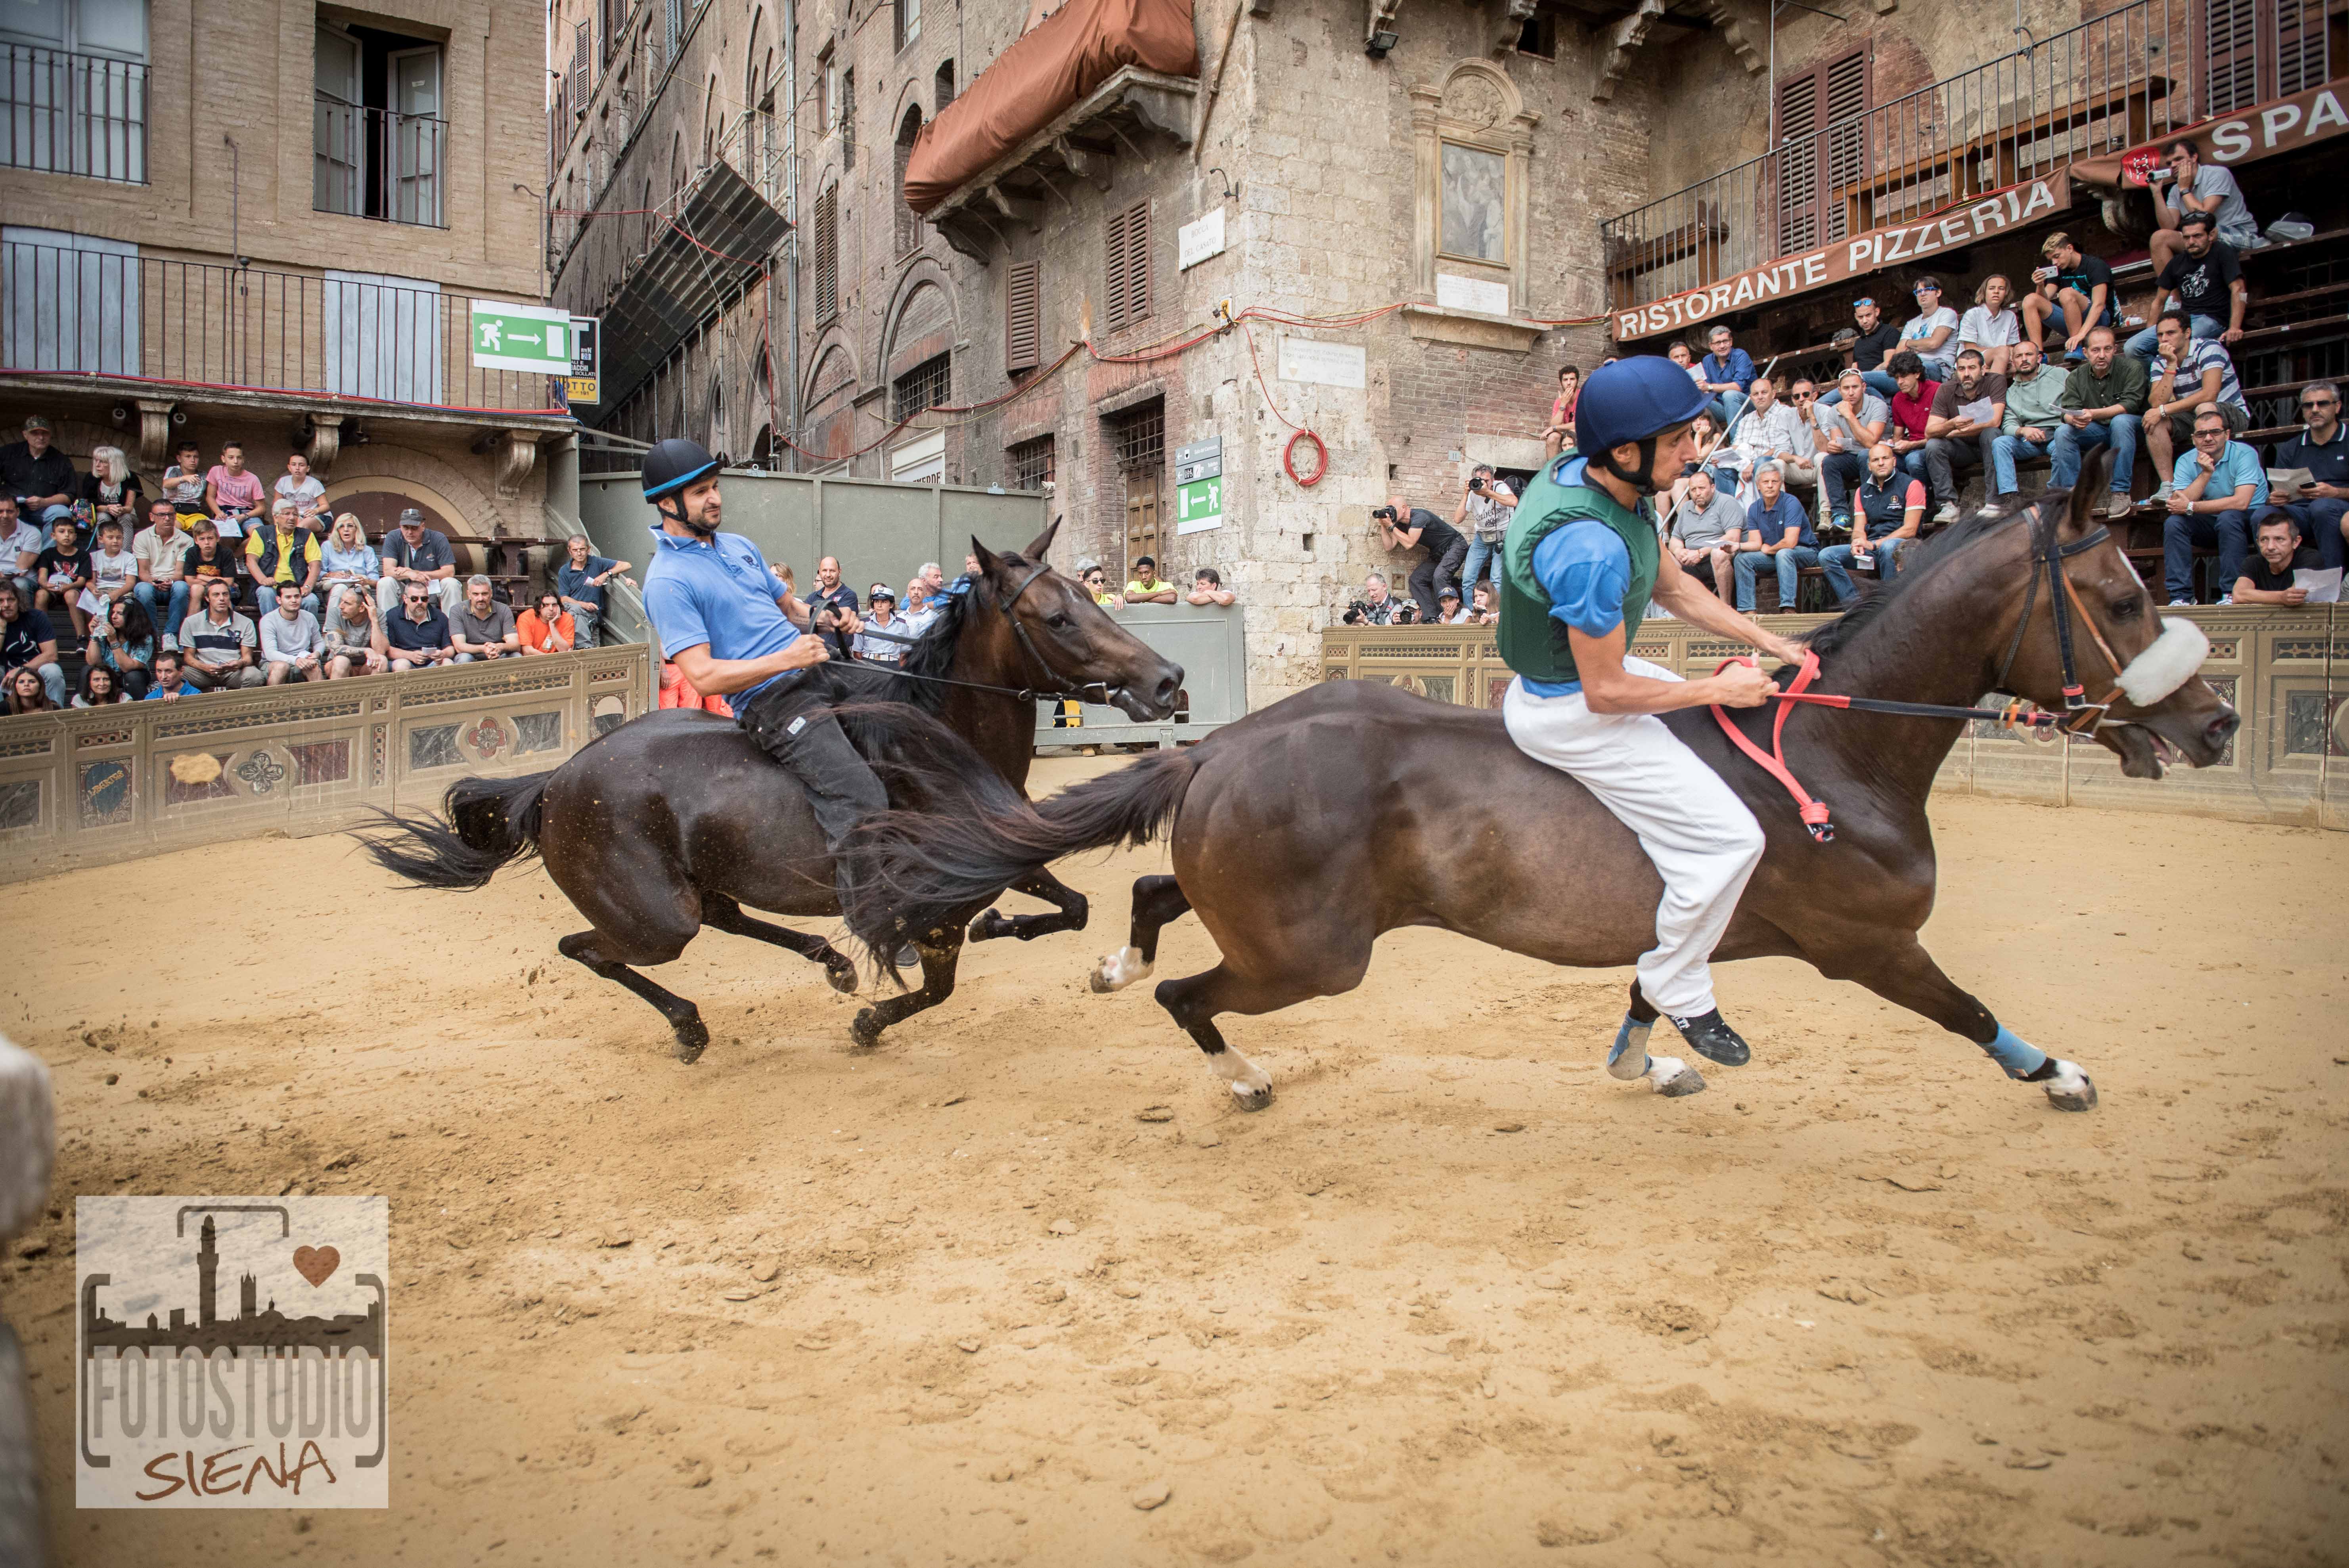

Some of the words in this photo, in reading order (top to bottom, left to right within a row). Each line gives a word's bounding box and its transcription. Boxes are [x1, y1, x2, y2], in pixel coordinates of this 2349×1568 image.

[1191, 224, 1208, 238] BOCCA
[1185, 247, 1193, 258] DEL
[1196, 237, 1216, 252] CASATO
[1620, 253, 1827, 338] RISTORANTE
[1849, 181, 2055, 272] PIZZERIA
